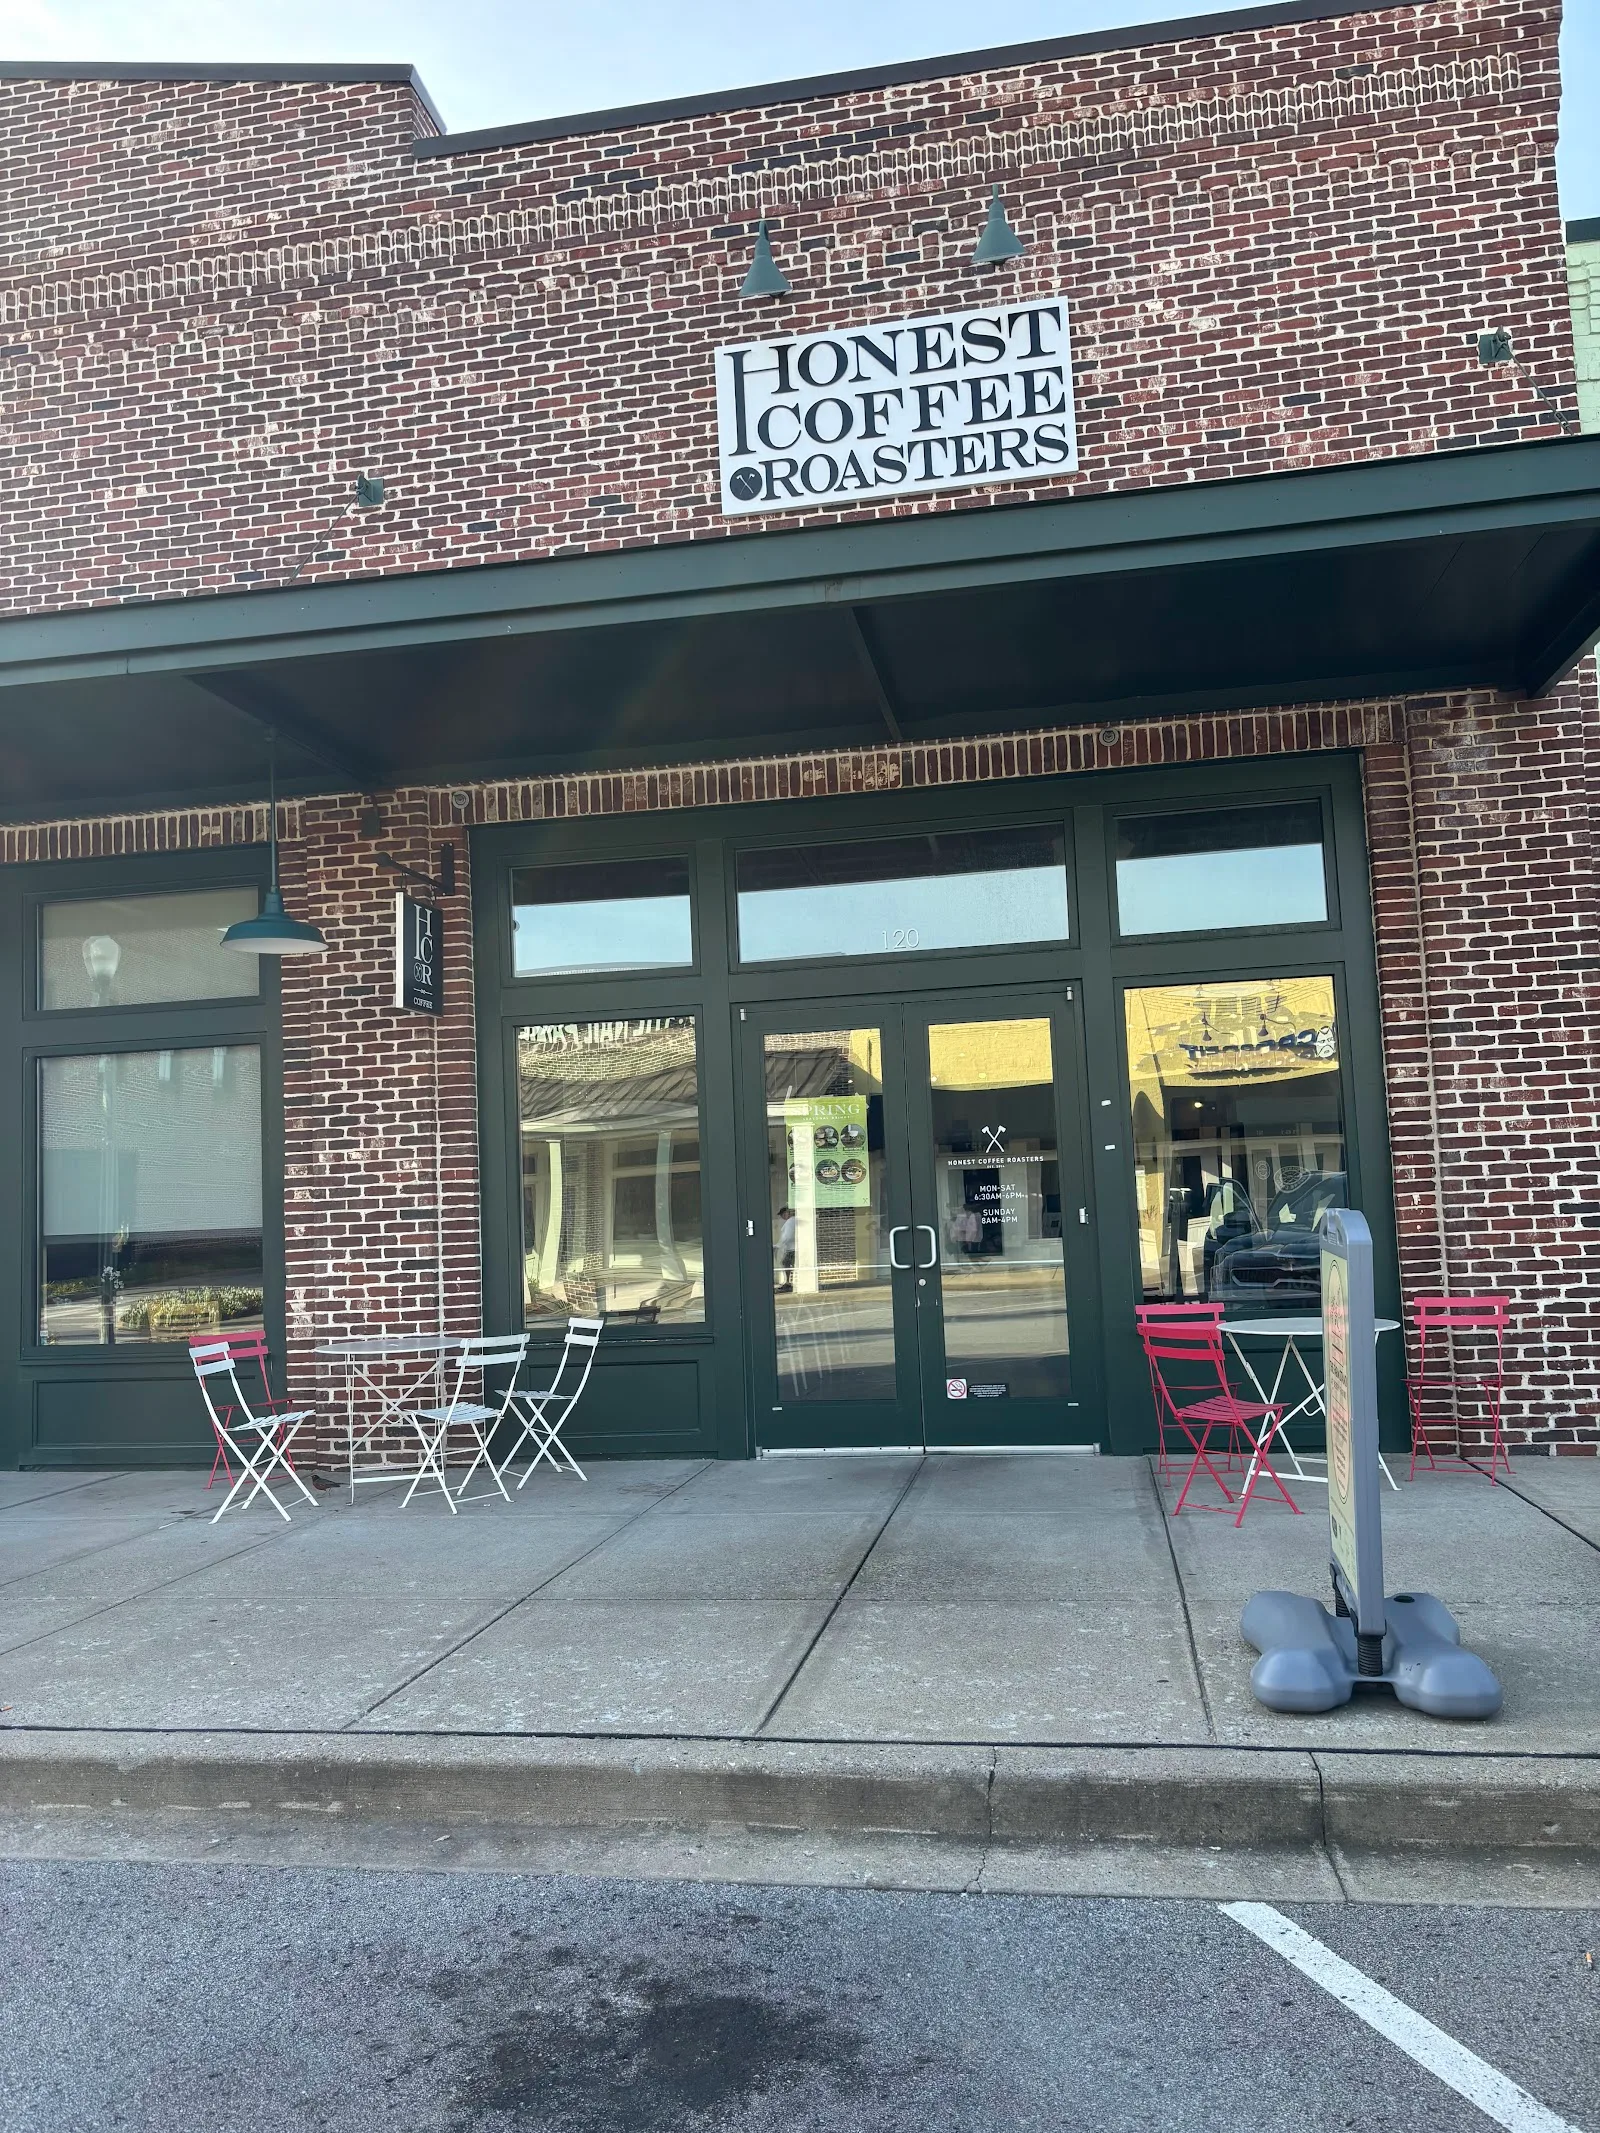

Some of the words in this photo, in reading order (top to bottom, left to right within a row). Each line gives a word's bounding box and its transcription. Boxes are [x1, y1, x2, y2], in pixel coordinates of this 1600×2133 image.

[723, 306, 1062, 456] HONEST
[757, 366, 1067, 451] COFFEE
[760, 423, 1070, 501] ROASTERS
[882, 928, 920, 950] 120
[413, 996, 433, 1010] COFFEE
[793, 1103, 861, 1117] PRING
[977, 1157, 1005, 1165] COFFEE
[1006, 1155, 1044, 1163] ROASTERS
[979, 1184, 1016, 1192] MON-SAT
[974, 1192, 1022, 1201] 6:30AM-6PM
[982, 1208, 1015, 1216] SUNDAY
[981, 1216, 1018, 1225] 8AM-4PM
